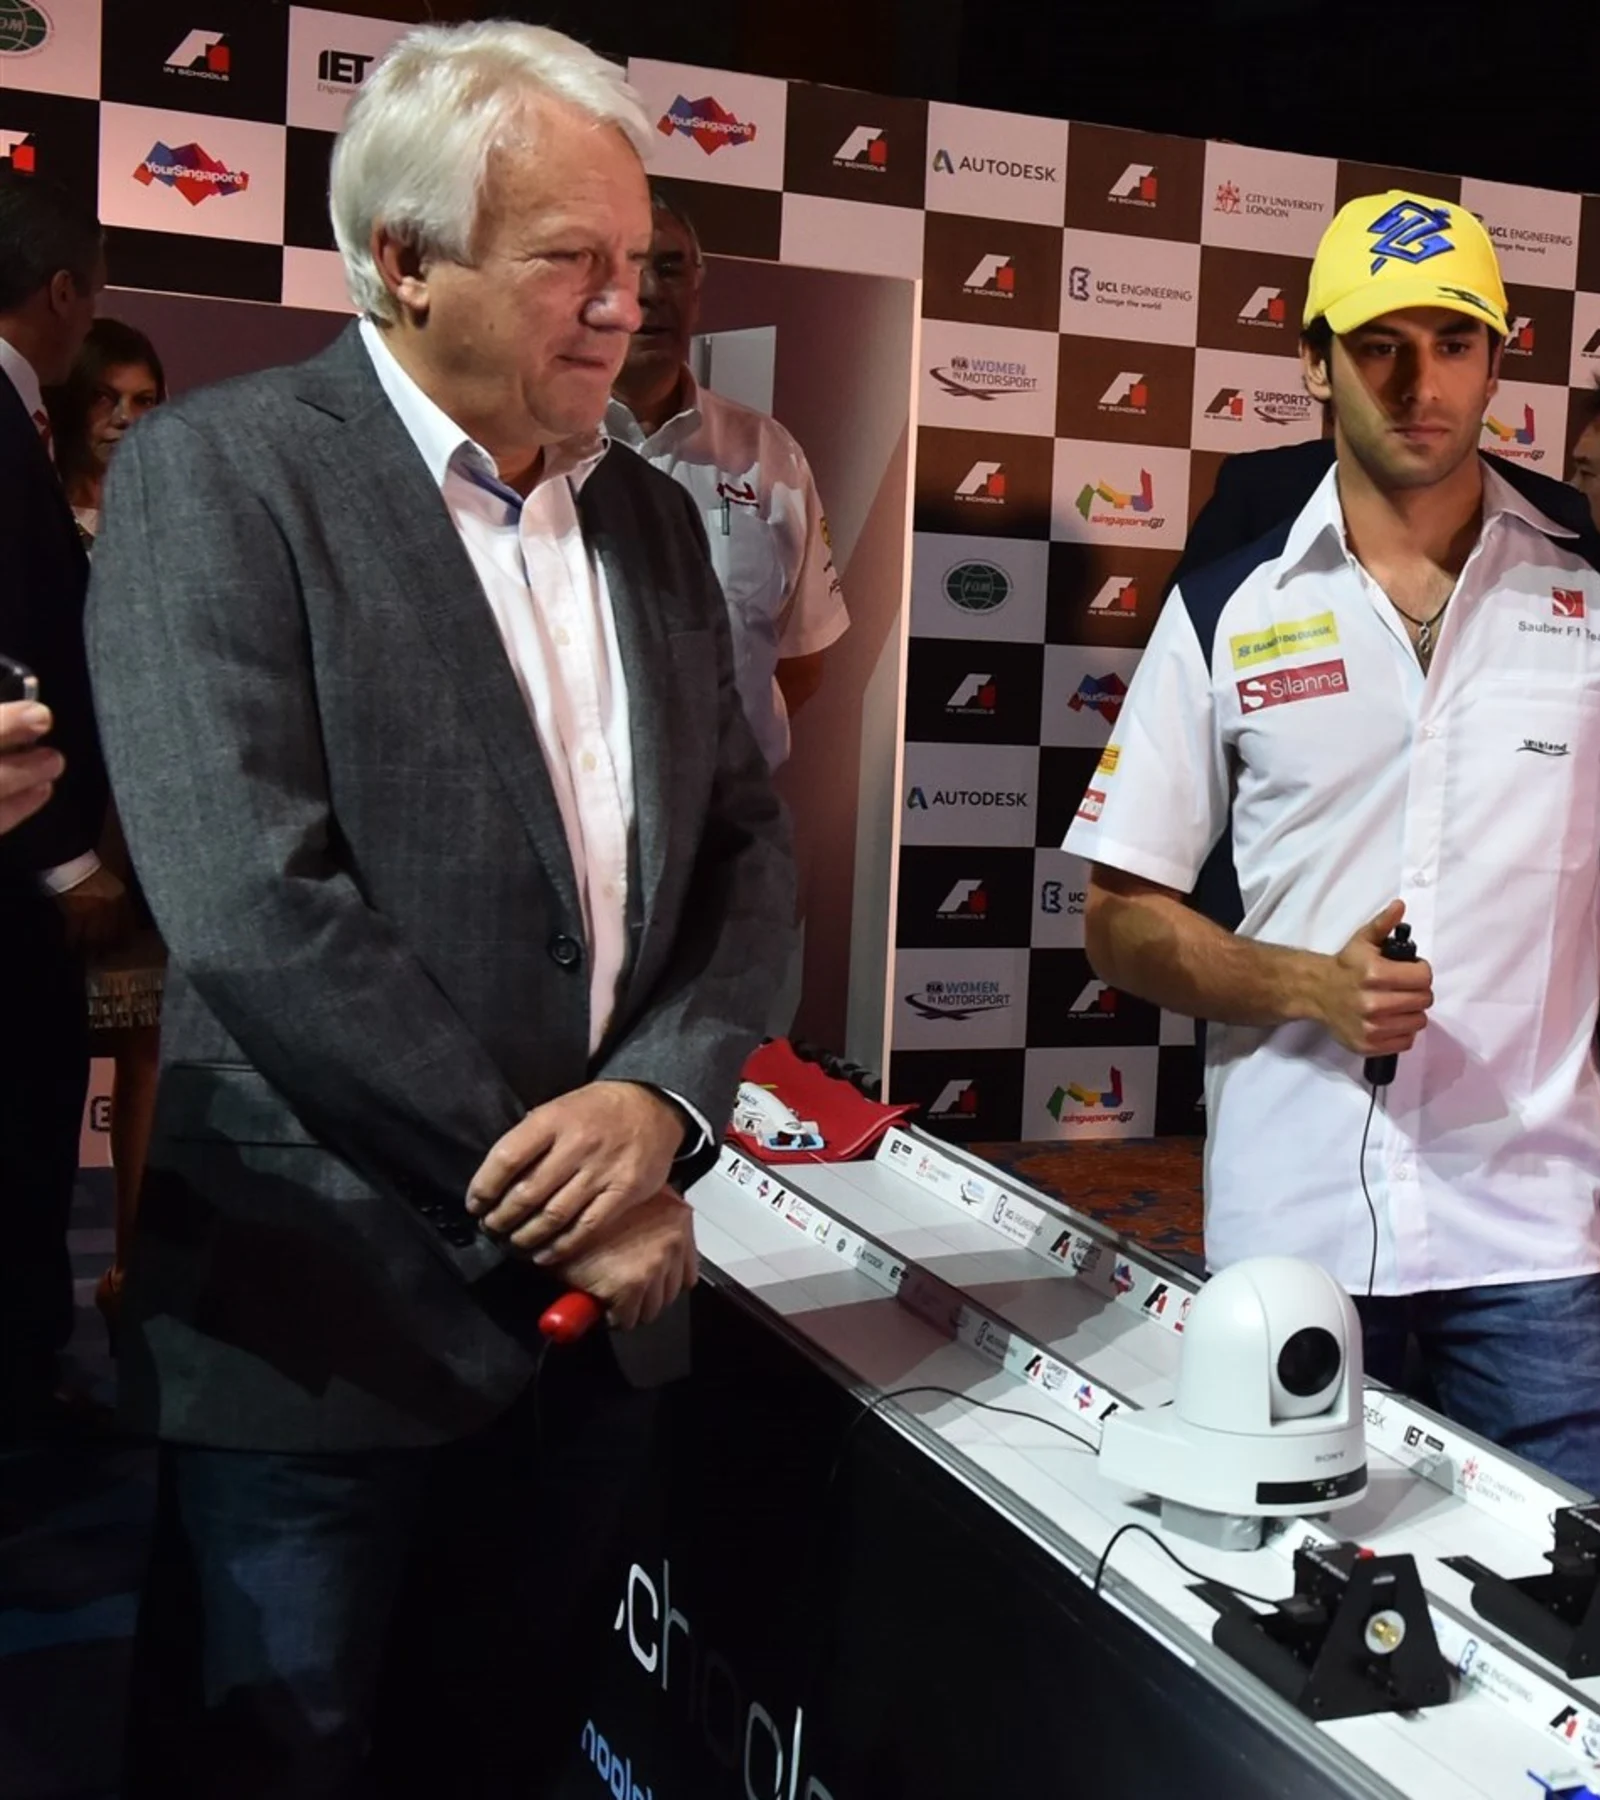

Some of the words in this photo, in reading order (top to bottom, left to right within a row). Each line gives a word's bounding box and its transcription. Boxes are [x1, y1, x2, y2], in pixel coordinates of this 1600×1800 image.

[163, 66, 176, 75] IN
[318, 49, 375, 85] IET
[668, 113, 751, 137] YourSingapore
[145, 160, 243, 186] YourSingapore
[959, 156, 1056, 183] AUTODESK
[1246, 205, 1290, 218] LONDON
[1270, 197, 1324, 213] UNIVERSITY
[1510, 229, 1573, 248] ENGINEERING
[1121, 283, 1193, 302] ENGINEERING
[971, 359, 1027, 376] WOMEN
[963, 373, 1037, 390] MOTORSPORT
[1254, 390, 1312, 407] SUPPORTS
[1090, 514, 1166, 530] singaporeGP
[1518, 620, 1562, 636] Sauber
[1567, 626, 1581, 637] F1
[1270, 672, 1344, 698] Silanna
[932, 791, 1027, 807] AUTODESK
[945, 981, 999, 994] WOMEN
[937, 993, 1011, 1006] MOTORSPORT
[1061, 1110, 1135, 1124] singaporeGP
